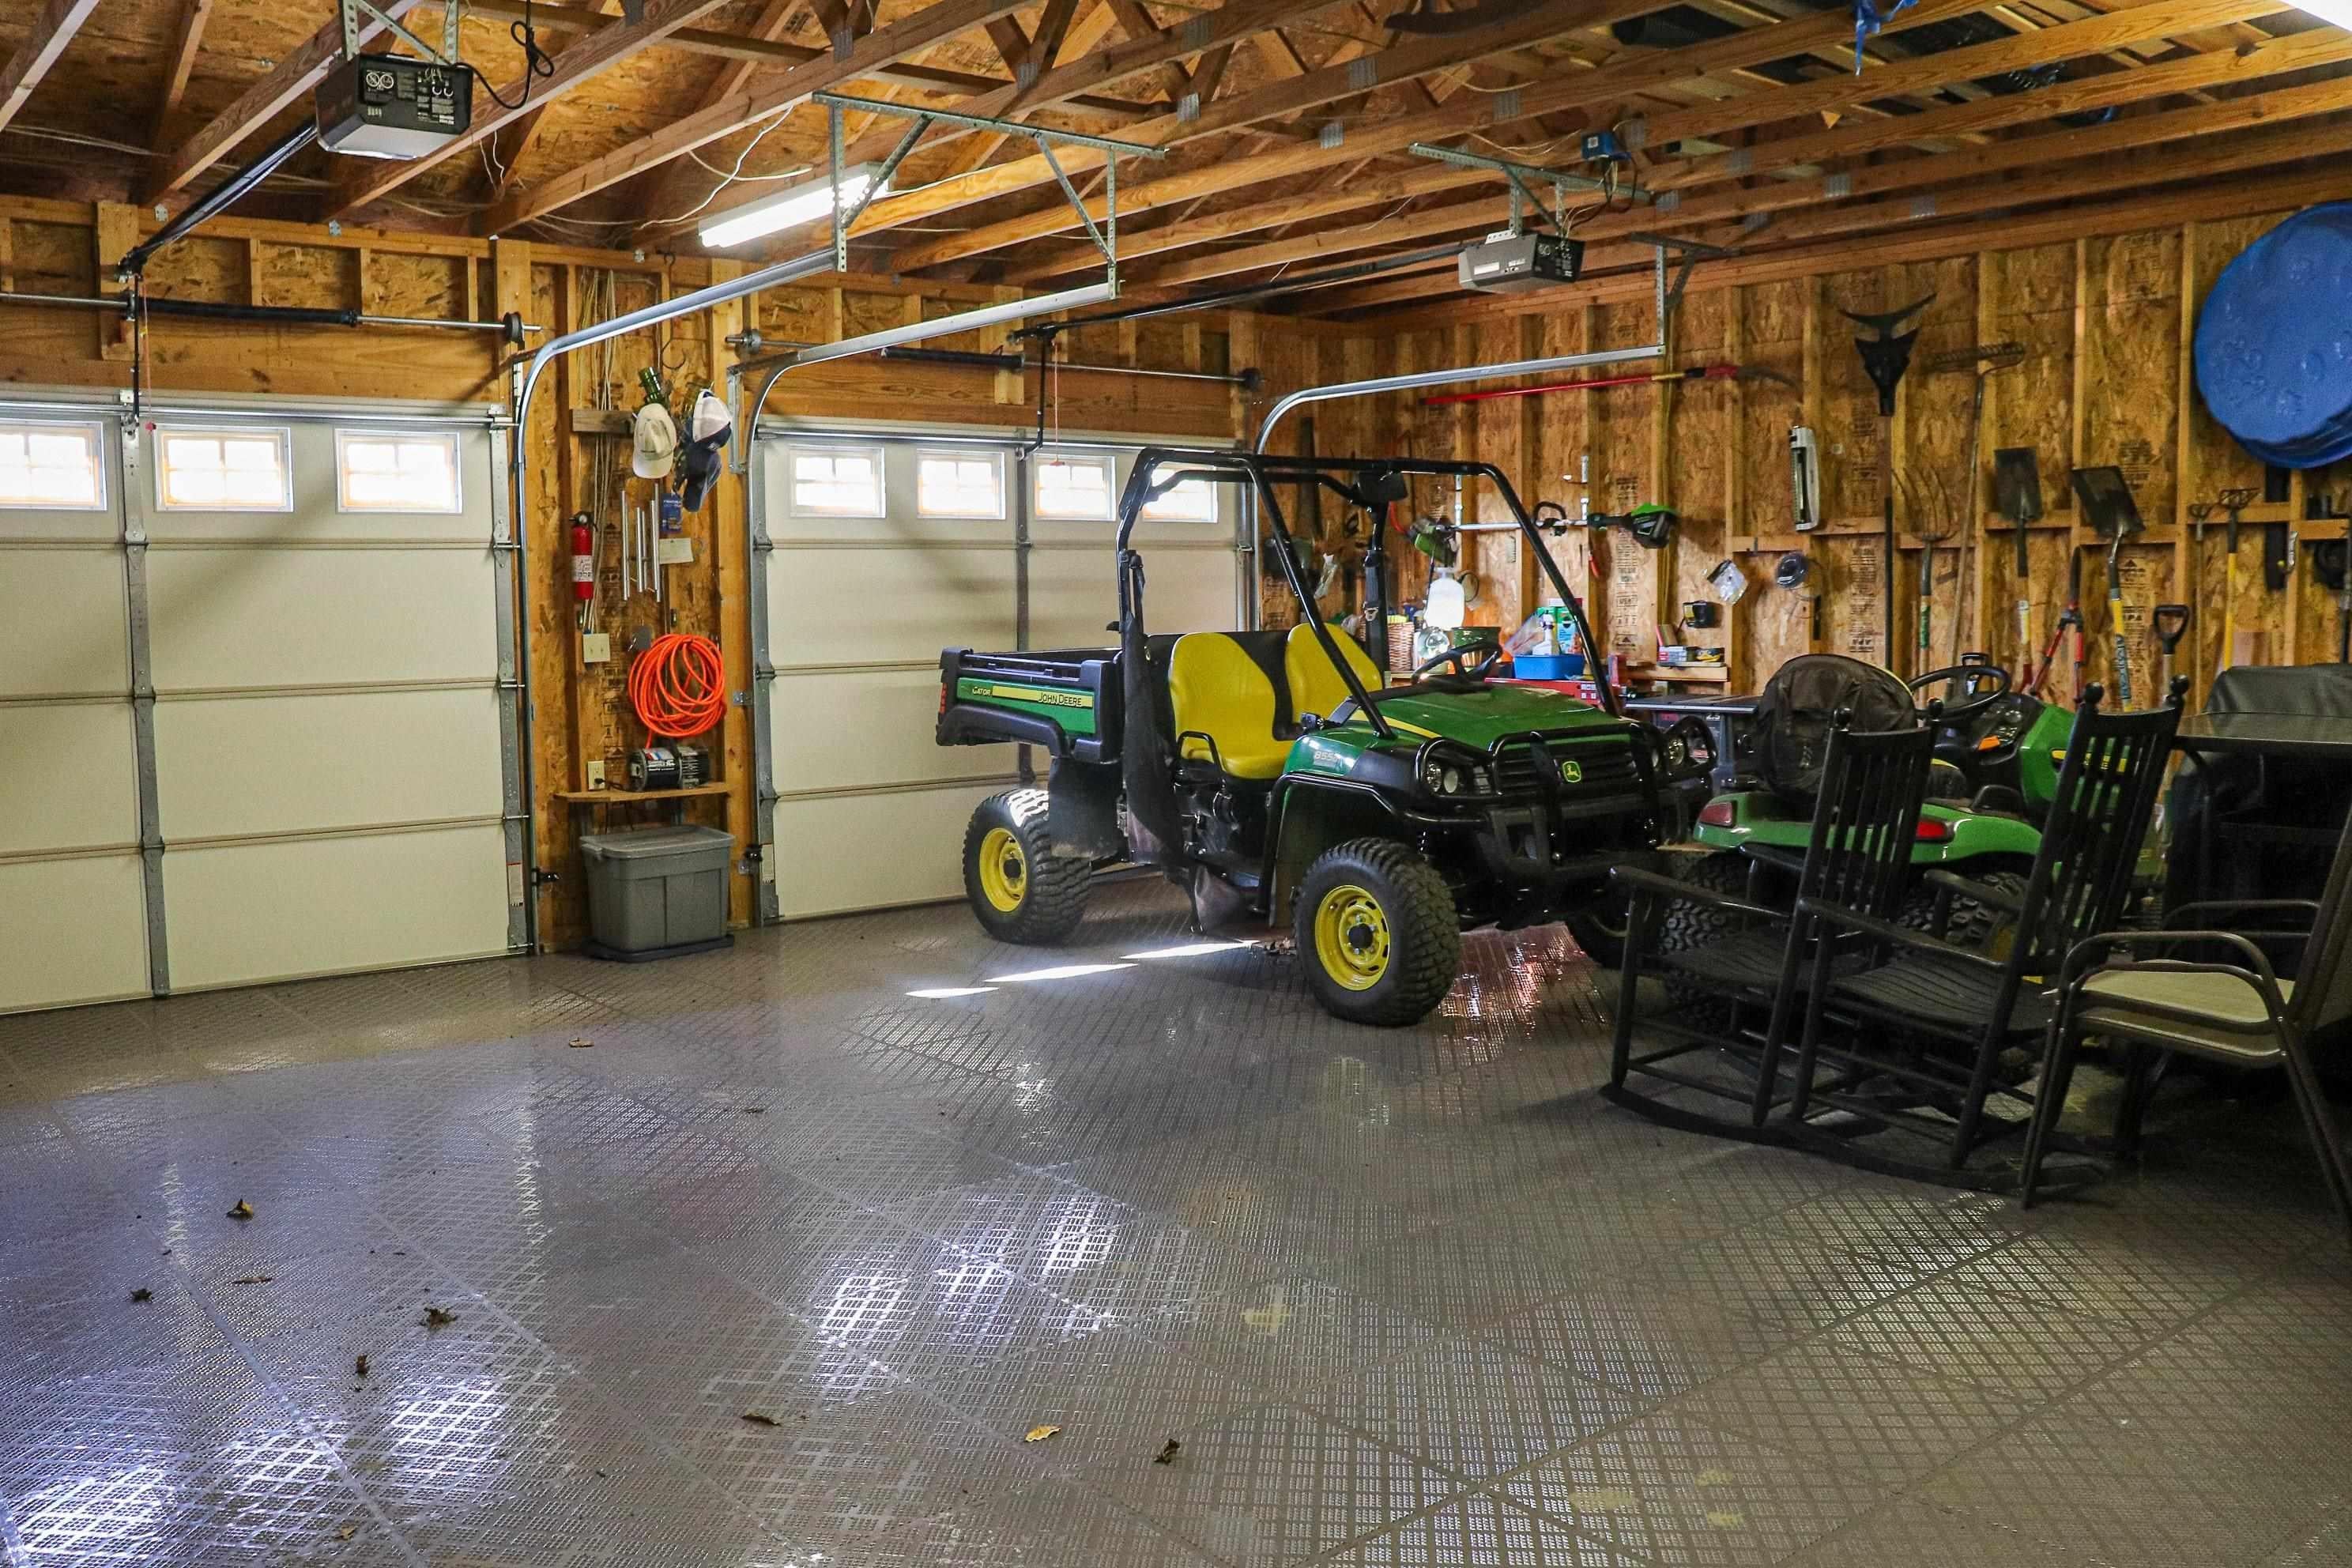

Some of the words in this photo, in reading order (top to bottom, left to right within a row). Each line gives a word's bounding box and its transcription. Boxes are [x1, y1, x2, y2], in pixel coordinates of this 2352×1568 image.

[972, 686, 991, 696] GATOR
[1038, 692, 1057, 703] JOHN
[1058, 694, 1082, 706] DEERE
